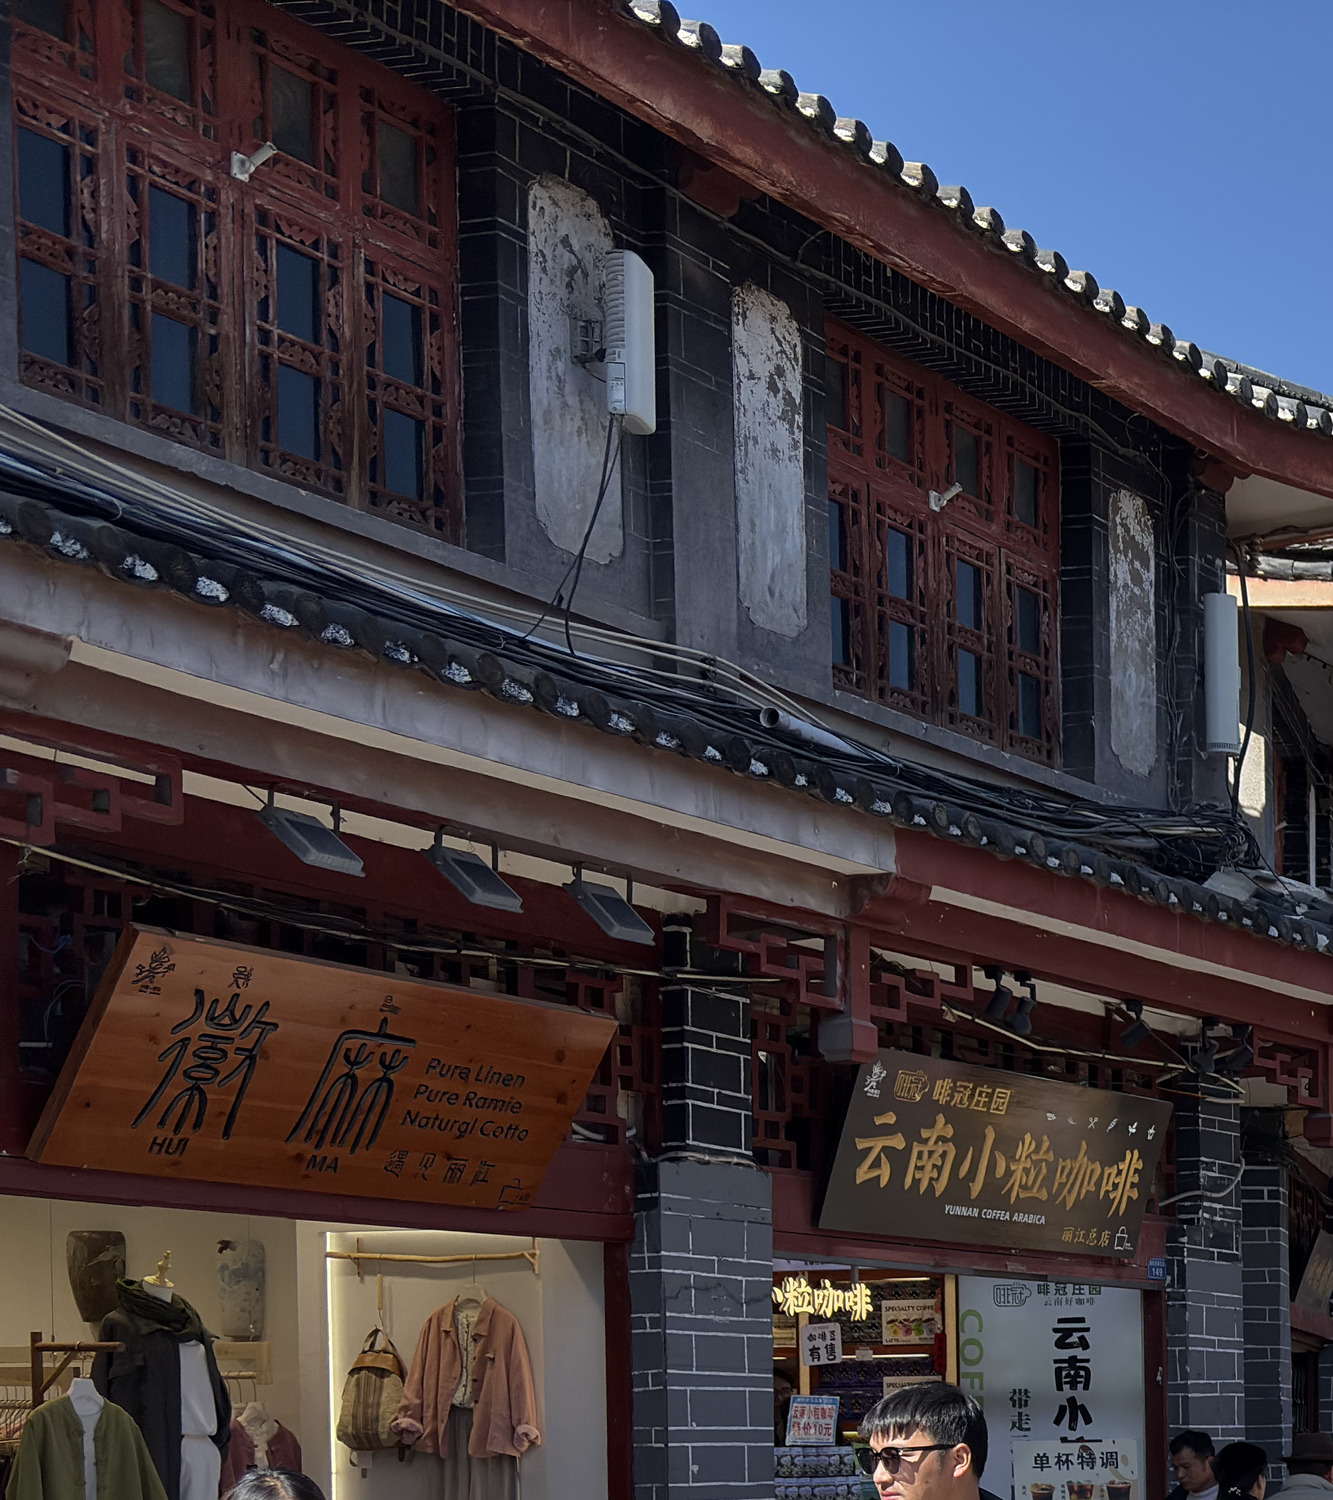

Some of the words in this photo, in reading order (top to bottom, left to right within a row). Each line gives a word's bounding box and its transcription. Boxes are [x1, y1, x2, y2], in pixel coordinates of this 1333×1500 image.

[426, 1058, 471, 1079] Pure
[475, 1065, 525, 1088] Linen
[413, 1084, 459, 1105] Pure
[463, 1091, 522, 1114] Ramie
[931, 1078, 1011, 1115] 啡冠庄园
[401, 1110, 478, 1136] Natural
[480, 1120, 529, 1141] Cotto
[148, 1137, 190, 1157] HUI
[305, 1155, 339, 1173] MA
[855, 1111, 1143, 1218] 云南小粒咖啡
[945, 1204, 978, 1218] YUNNAN
[981, 1208, 1010, 1221] COFFEA
[1012, 1212, 1046, 1225] ARABICA
[1061, 1227, 1111, 1248] 丽江总店
[1152, 1267, 1163, 1277] 149
[808, 1343, 837, 1362] 有售
[1052, 1317, 1103, 1443] 云南小
[1009, 1388, 1031, 1441] 带走
[1032, 1451, 1119, 1472] 单杯特调
